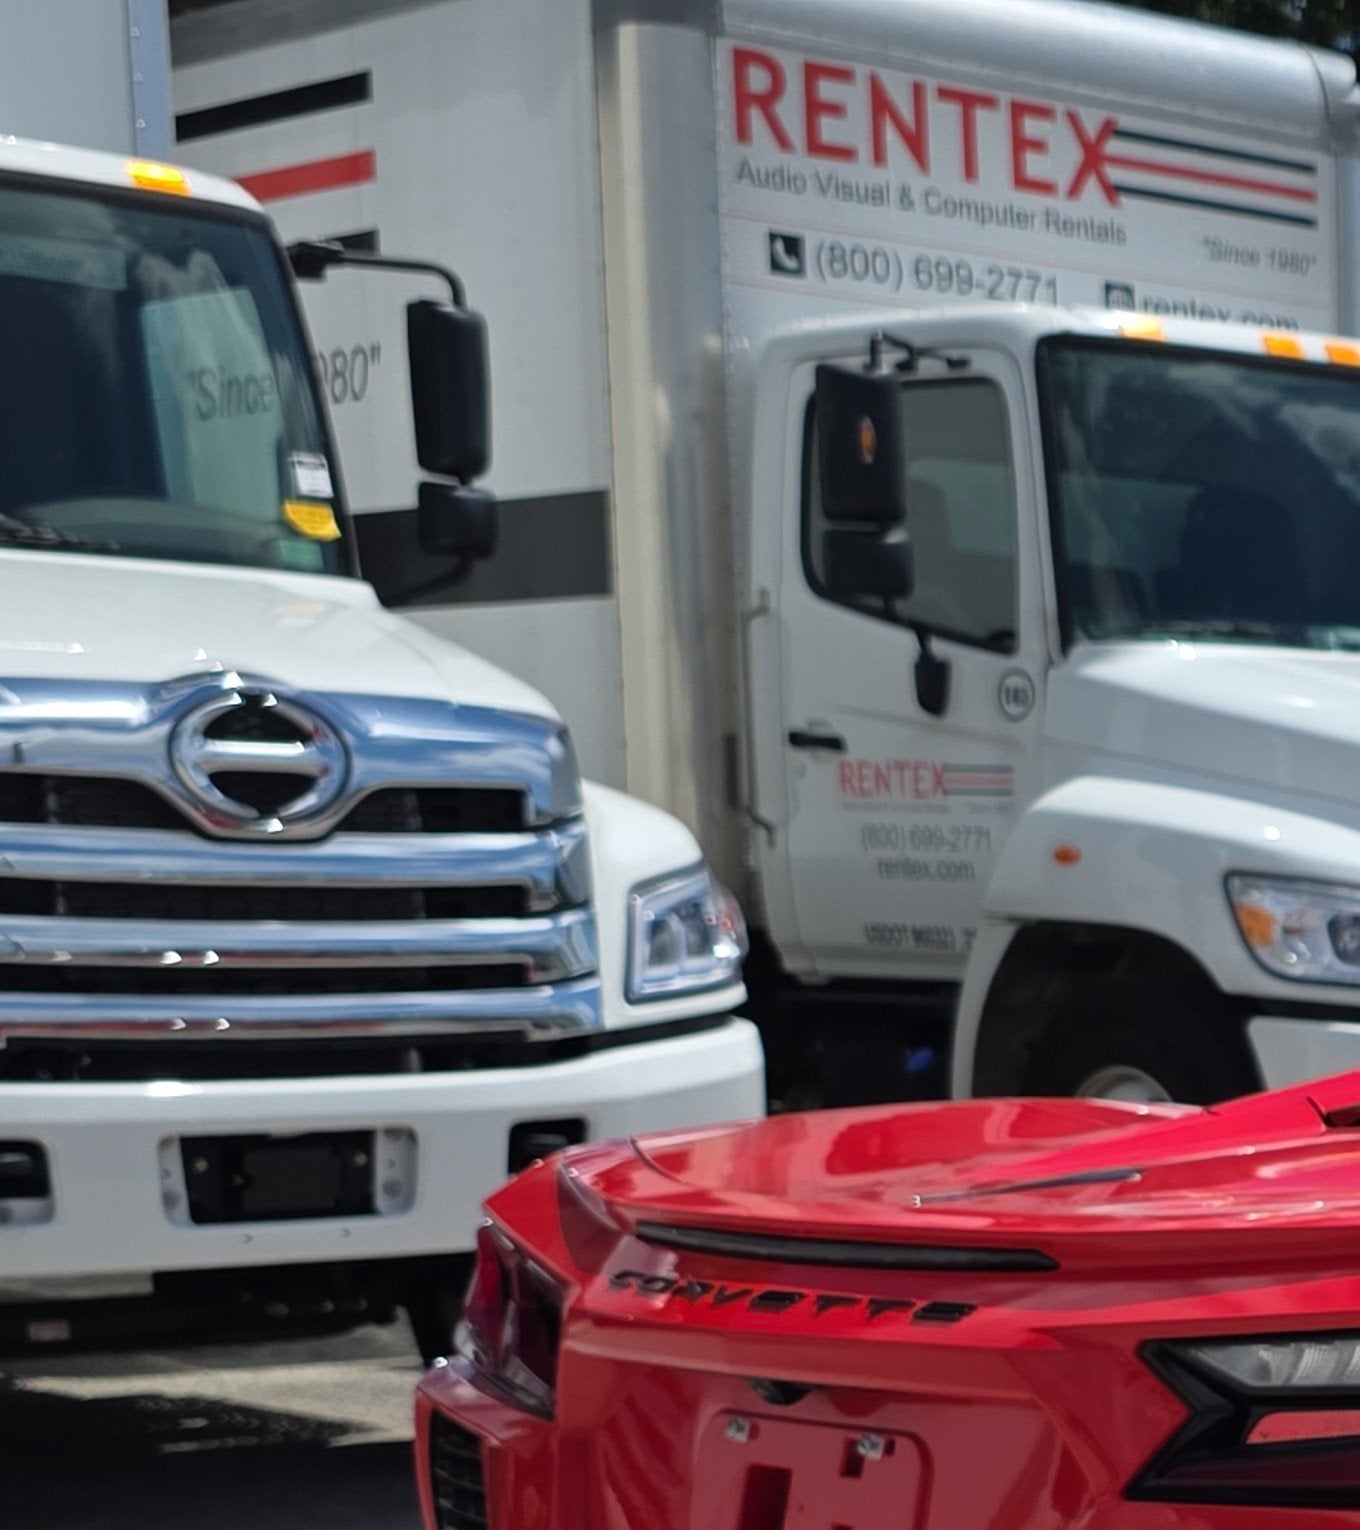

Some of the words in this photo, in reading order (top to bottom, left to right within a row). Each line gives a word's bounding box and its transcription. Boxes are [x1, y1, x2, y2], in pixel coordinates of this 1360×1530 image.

[732, 47, 1122, 206] RENTEX
[736, 158, 808, 195] Audio
[814, 168, 891, 207] Visual
[898, 183, 915, 212] &
[923, 186, 1035, 229] Computer
[1045, 207, 1128, 246] Rentals
[816, 240, 904, 293] (800)
[914, 252, 1058, 305] 699-2771
[838, 759, 949, 800] RENTEX
[608, 1270, 979, 1327] CORVETTE
